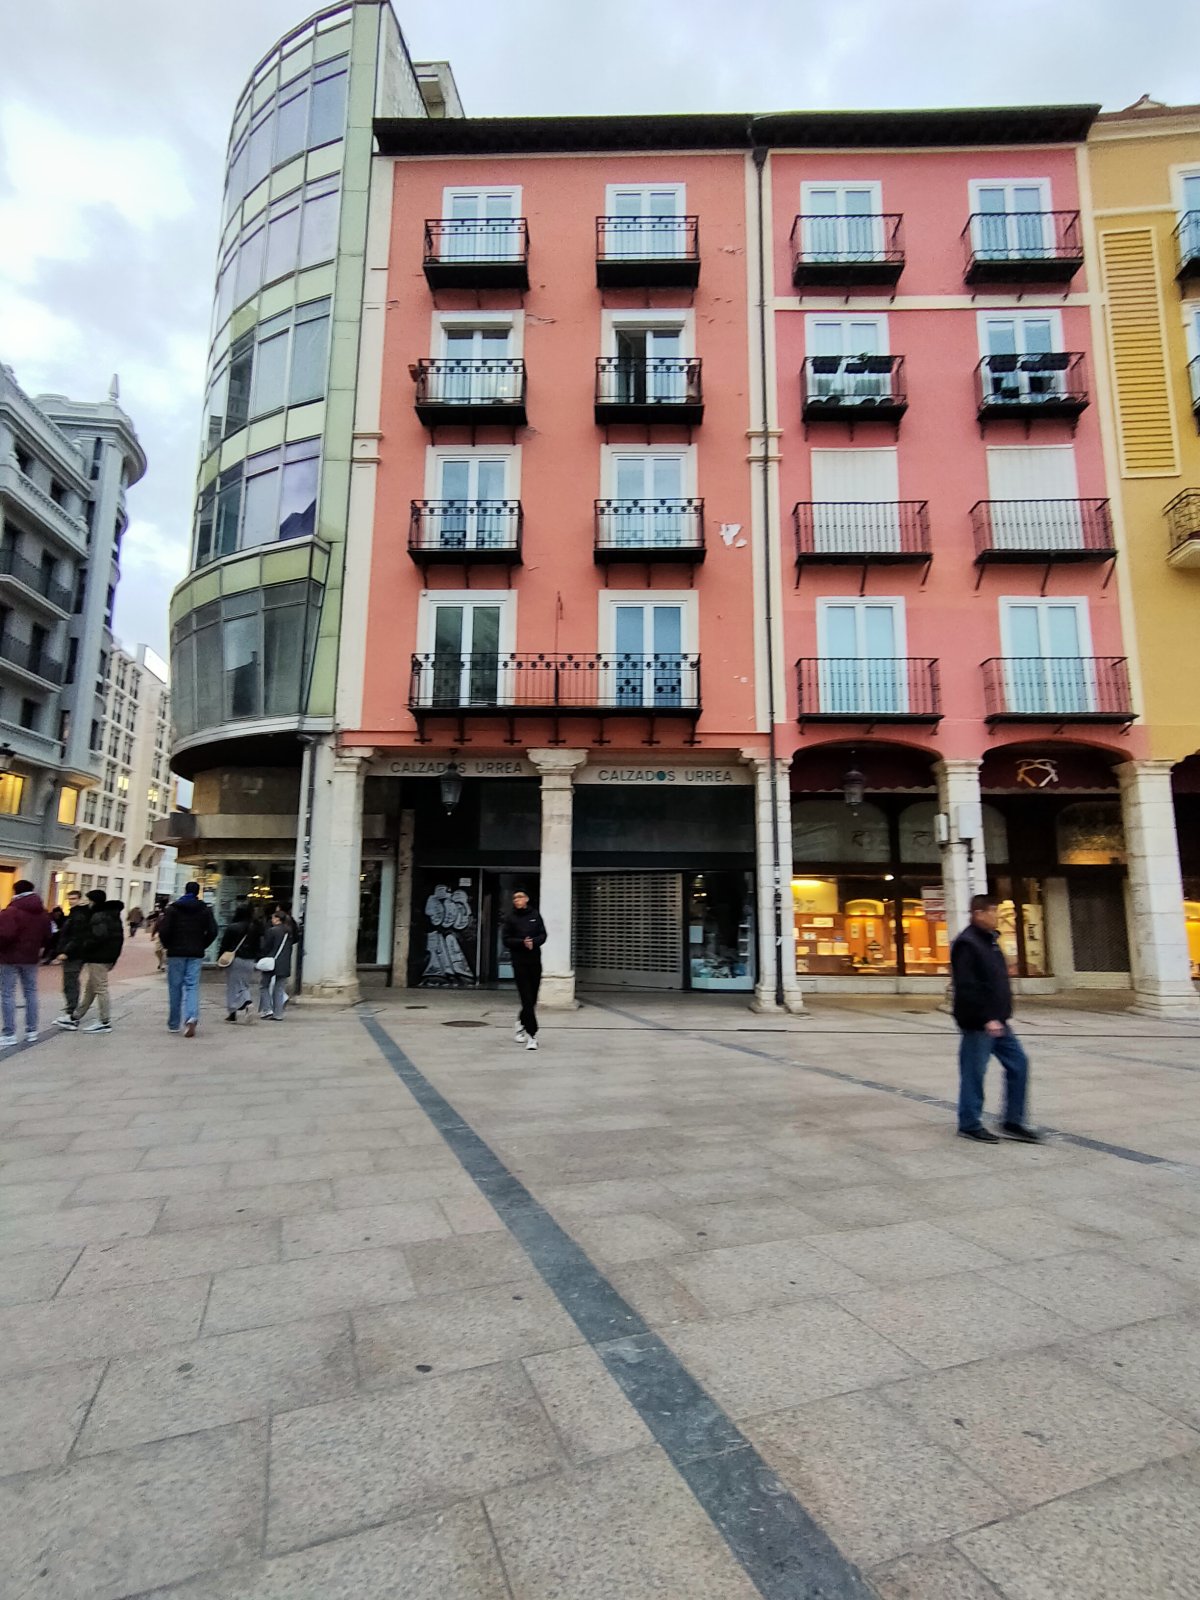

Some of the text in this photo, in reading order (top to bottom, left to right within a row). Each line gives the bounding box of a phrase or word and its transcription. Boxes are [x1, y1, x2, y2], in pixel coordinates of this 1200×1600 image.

[390, 762, 523, 774] CALZADS URREA
[598, 770, 733, 782] CALZADOS URREA
